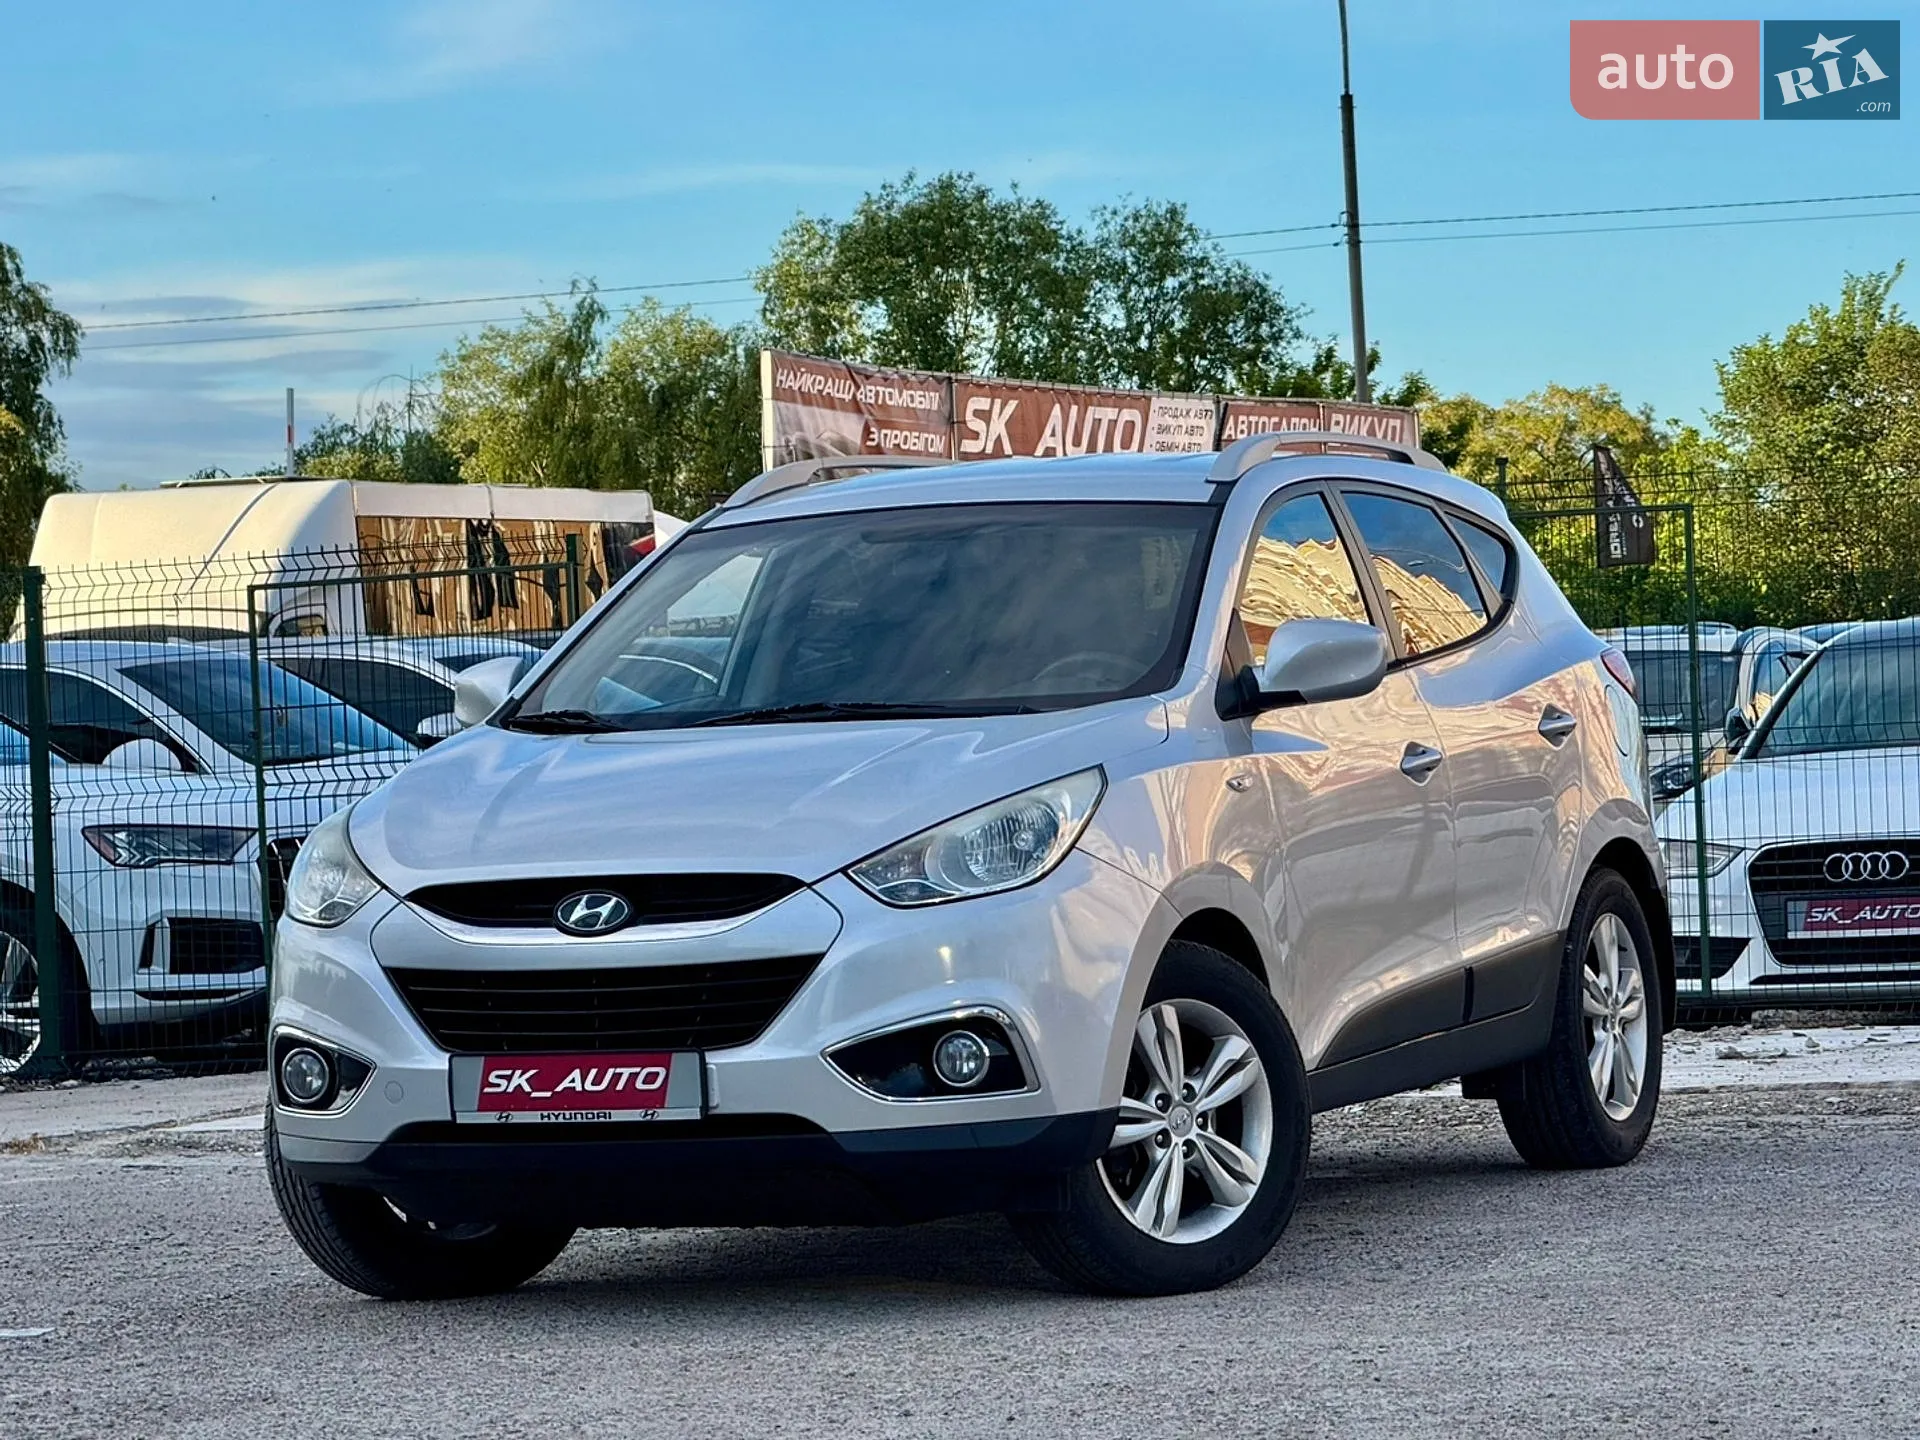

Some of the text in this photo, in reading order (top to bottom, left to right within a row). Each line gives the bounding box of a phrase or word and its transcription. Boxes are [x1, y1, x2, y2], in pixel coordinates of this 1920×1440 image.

[880, 427, 946, 454] ПРОБІГОМ
[1156, 424, 1205, 437] ВИКУП АВТО
[1806, 904, 1920, 924] SK_AUTO
[483, 1066, 667, 1098] SK_AUTO
[540, 1111, 612, 1121] HYUNDAI
